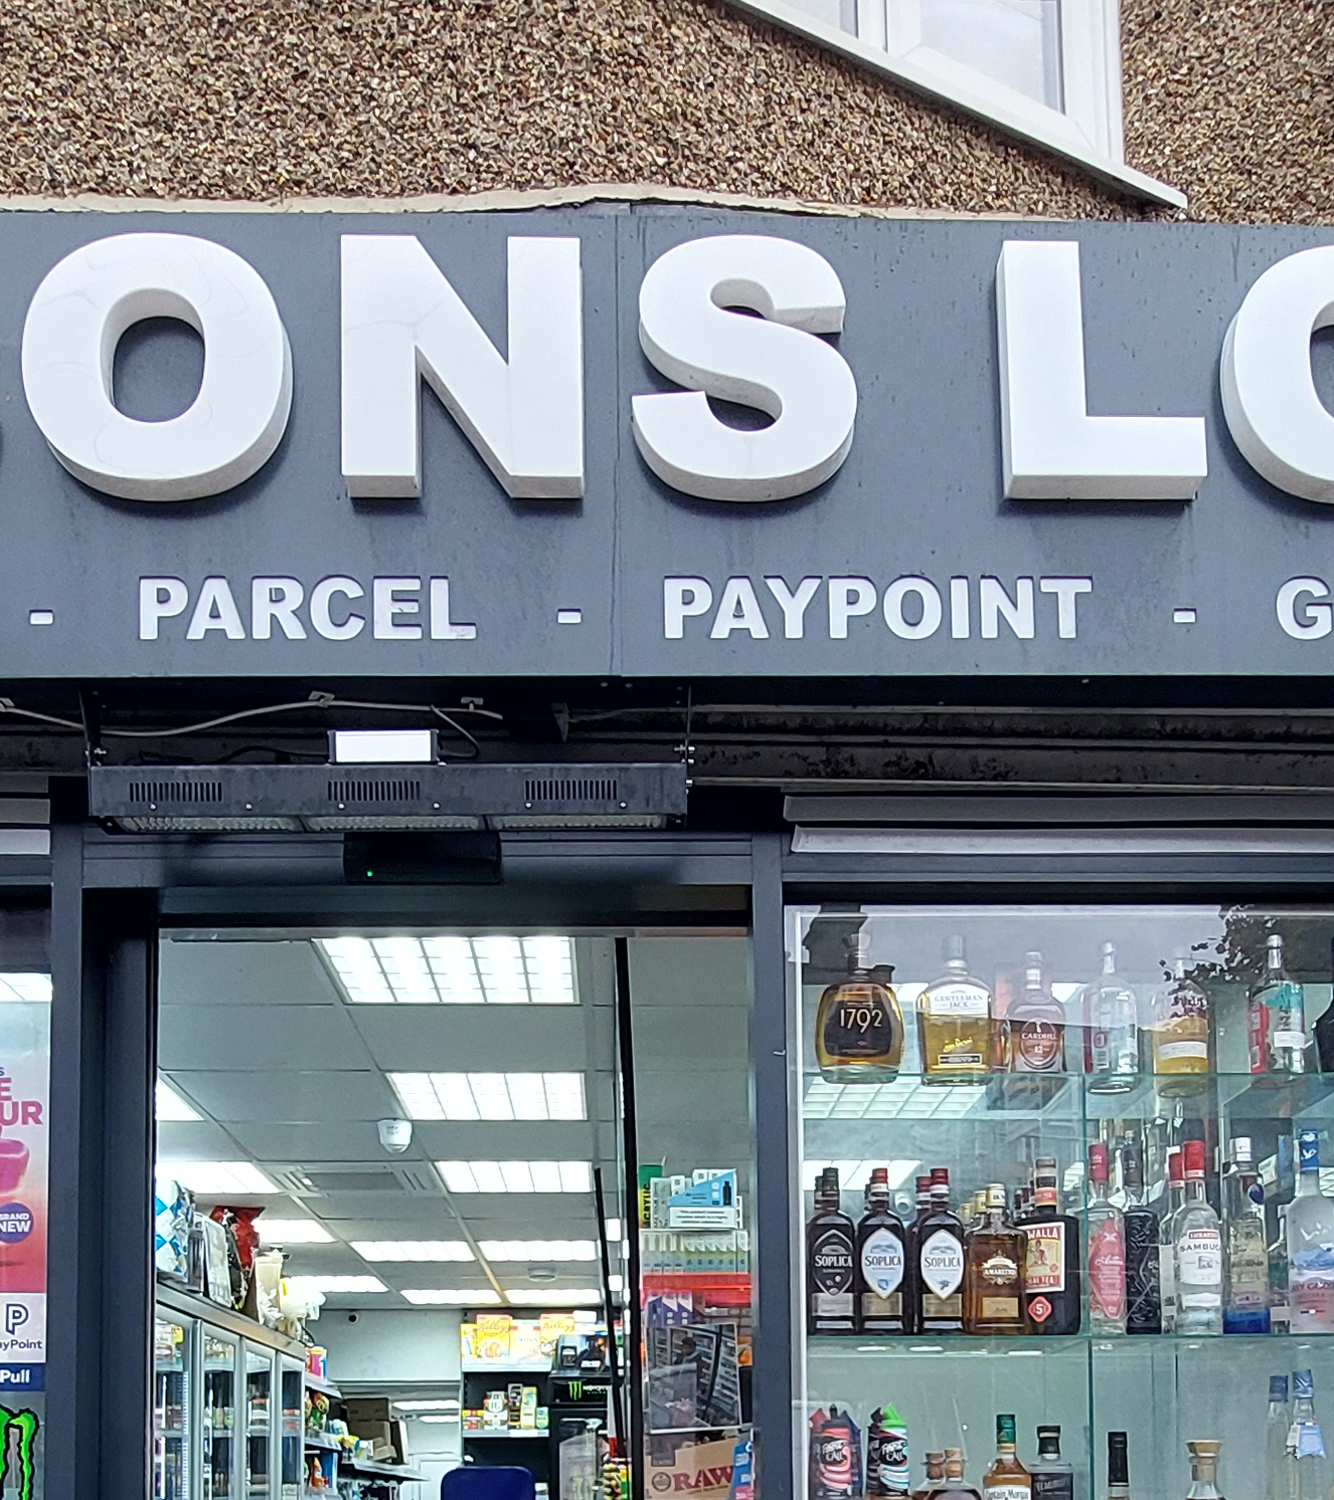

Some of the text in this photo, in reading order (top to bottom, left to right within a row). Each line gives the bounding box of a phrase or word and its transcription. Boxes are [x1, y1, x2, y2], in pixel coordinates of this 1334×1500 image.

[139, 577, 477, 641] PARCEL
[663, 577, 1092, 640] PAYPOINT
[839, 1008, 883, 1035] 1792
[814, 1254, 853, 1268] SOPLICA
[864, 1253, 902, 1267] SOPLICA
[924, 1255, 961, 1268] SOPLICA
[672, 1464, 734, 1492] RAW
